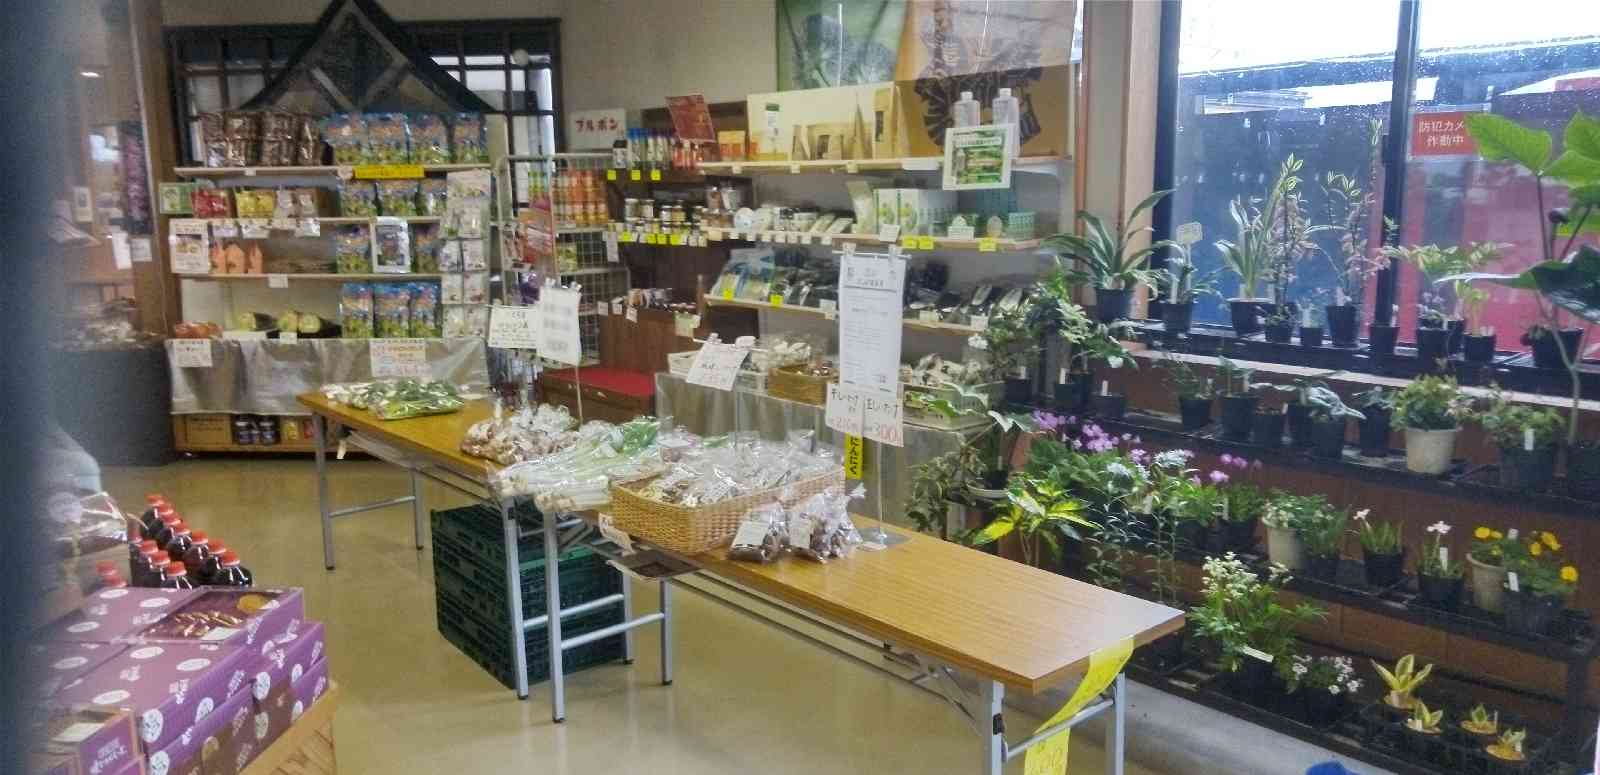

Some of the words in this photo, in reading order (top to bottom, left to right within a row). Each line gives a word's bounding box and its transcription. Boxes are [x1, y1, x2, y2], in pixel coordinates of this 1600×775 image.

[575, 117, 618, 132] ブルボン
[1418, 119, 1465, 133] 防犯カメ
[1427, 134, 1465, 148] 作動中
